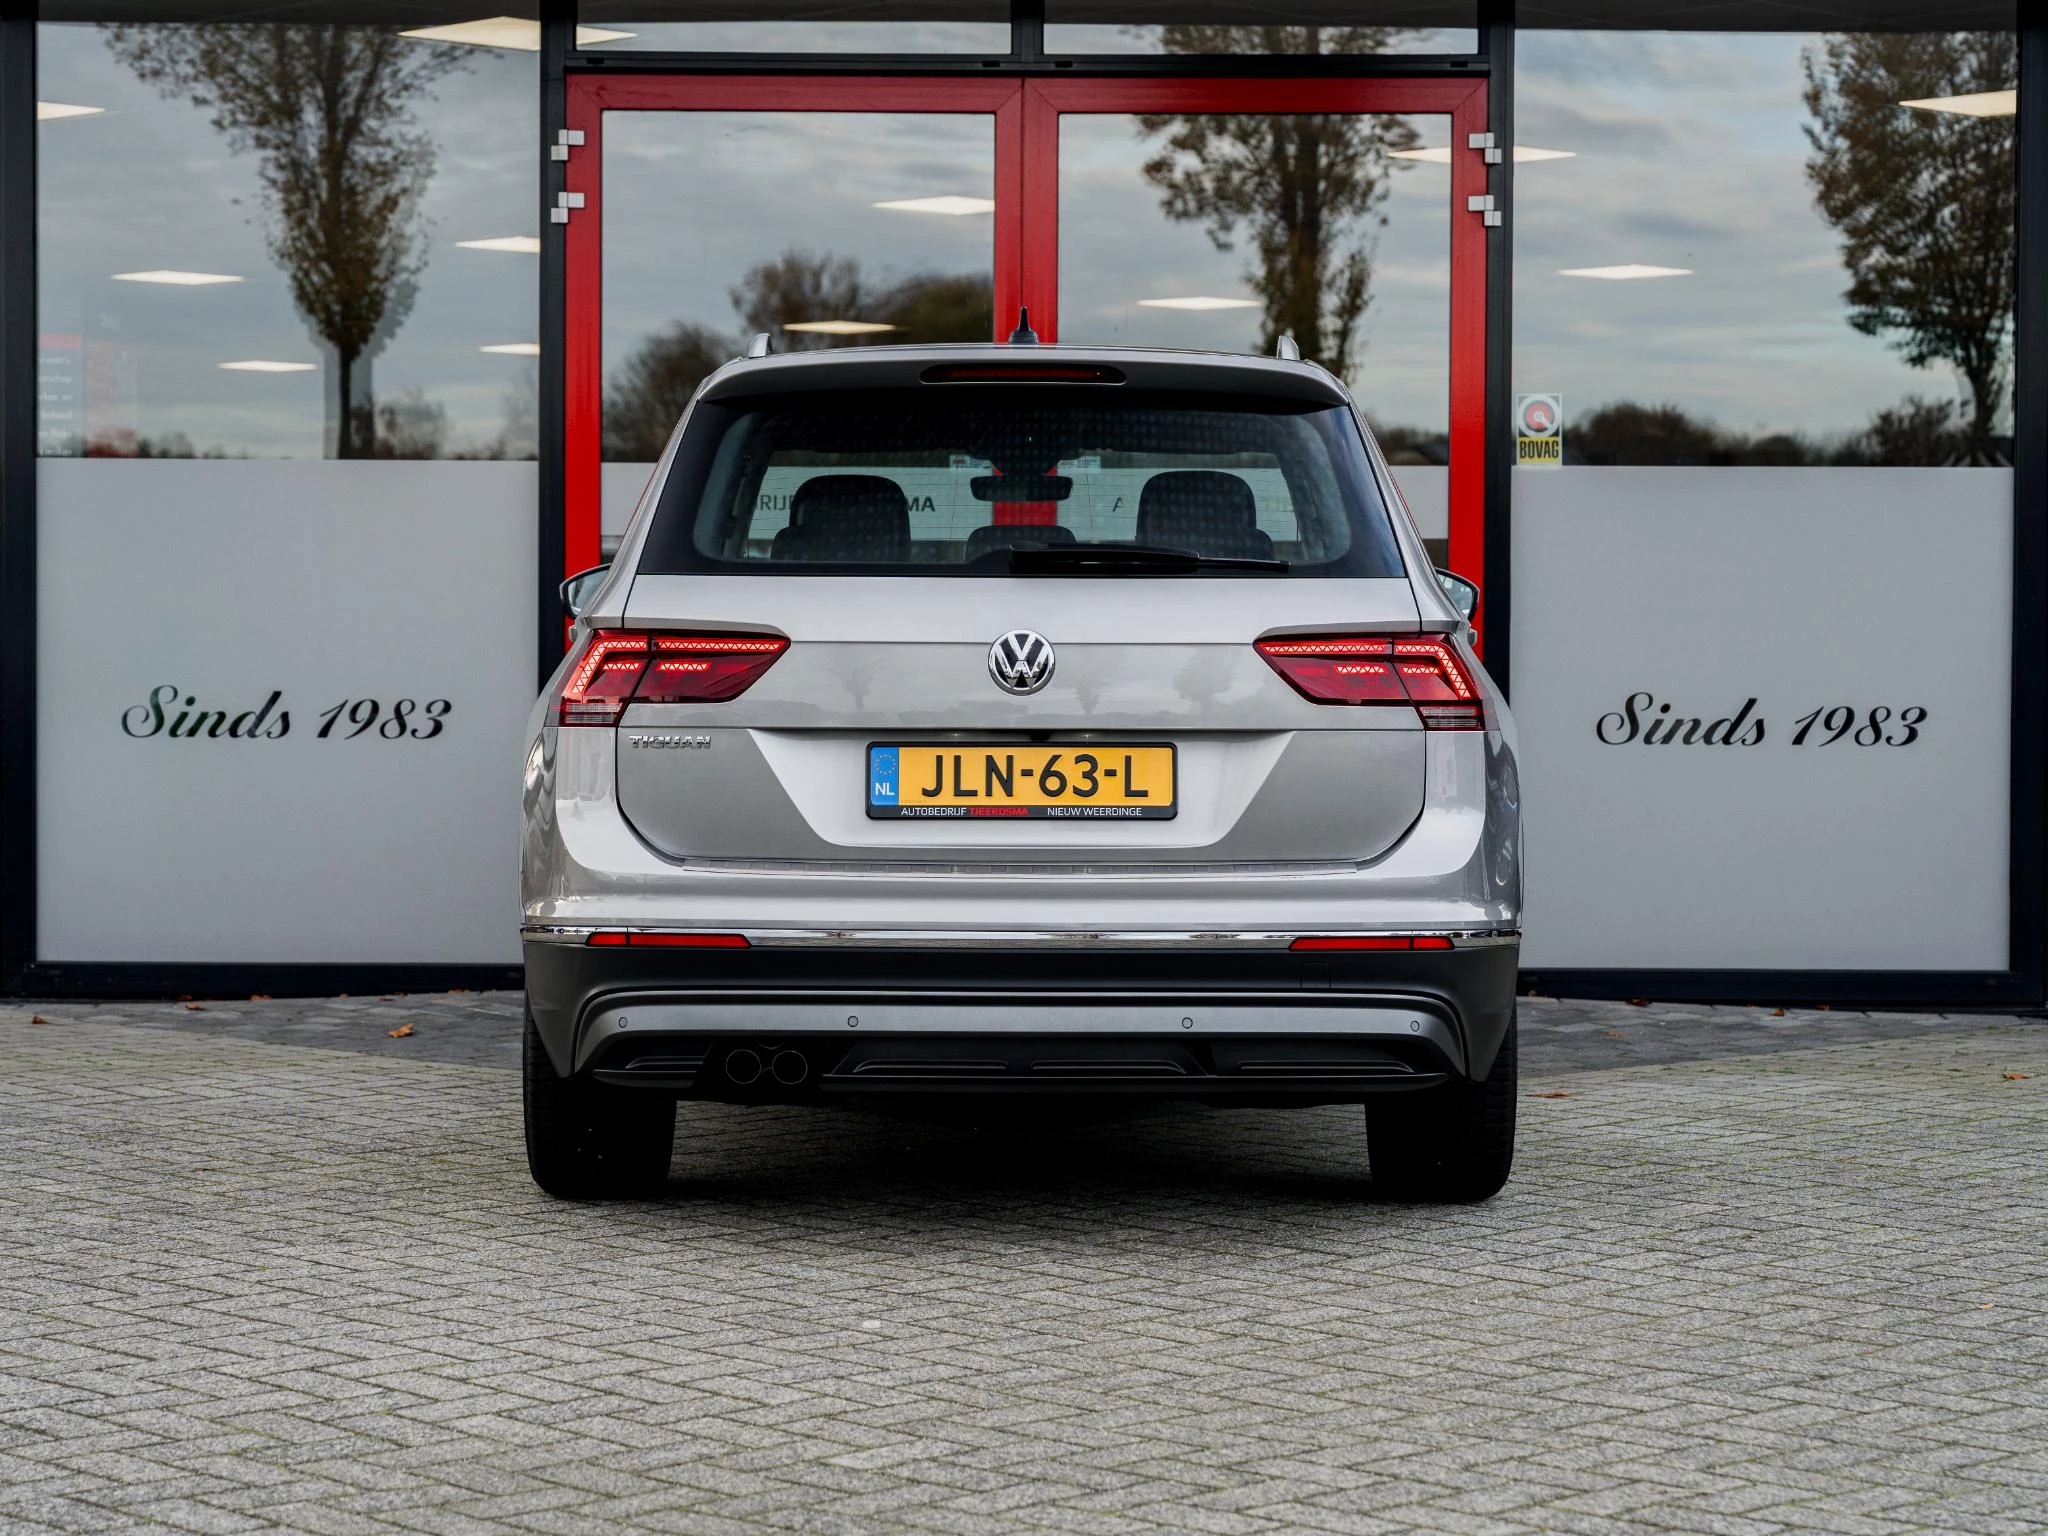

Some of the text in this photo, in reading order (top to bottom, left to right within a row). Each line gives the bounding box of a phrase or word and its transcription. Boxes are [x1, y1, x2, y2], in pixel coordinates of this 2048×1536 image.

[1519, 440, 1560, 459] BOVAG
[121, 684, 452, 740] Sinds 1983
[1596, 691, 1928, 747] Sinds 1983
[628, 735, 712, 749] TIGUAN
[921, 753, 1149, 797] JLN-63-L
[875, 782, 895, 796] NL
[901, 807, 1142, 816] AUTOBEDRIJF TJEERDSMA NIEUW WEERDINGE
